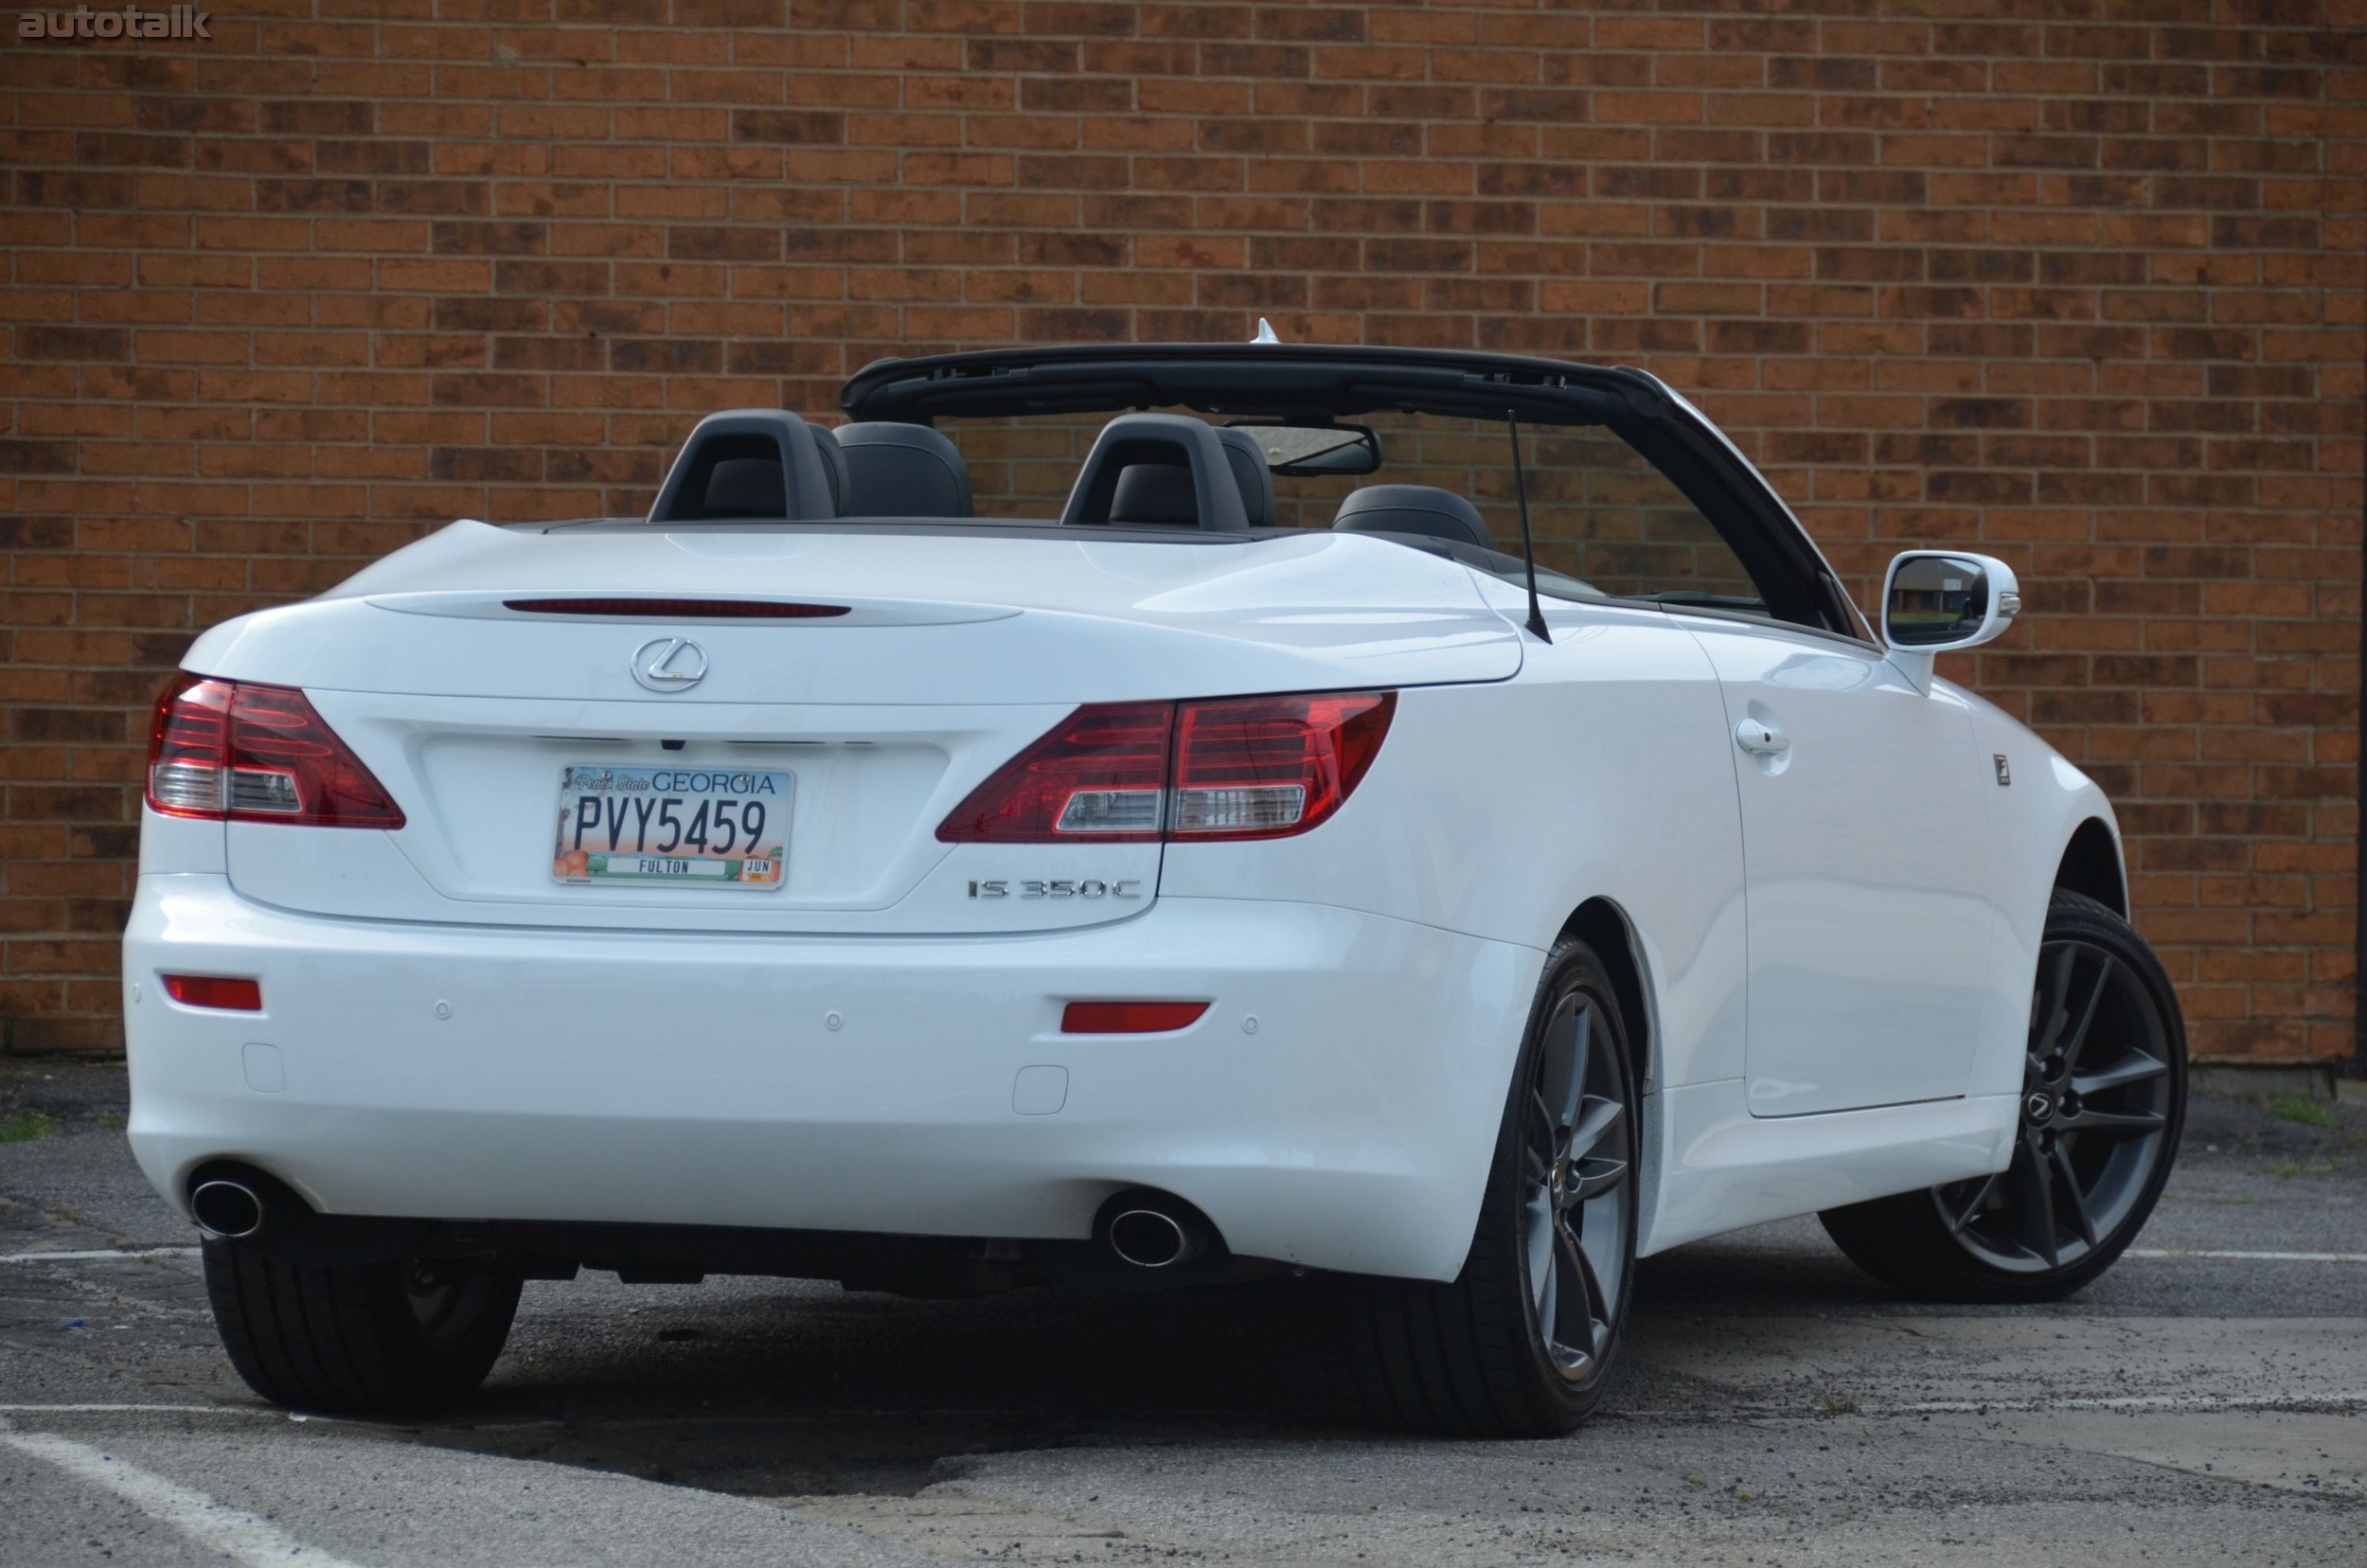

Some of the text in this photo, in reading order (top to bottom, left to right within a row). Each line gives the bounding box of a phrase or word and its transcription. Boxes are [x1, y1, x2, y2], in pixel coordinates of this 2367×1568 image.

[614, 775, 650, 792] State
[651, 772, 775, 795] GEORGIA
[574, 795, 766, 855] PVY5459
[639, 859, 688, 873] FULTON
[746, 860, 769, 872] JUN
[968, 880, 1009, 898] IS
